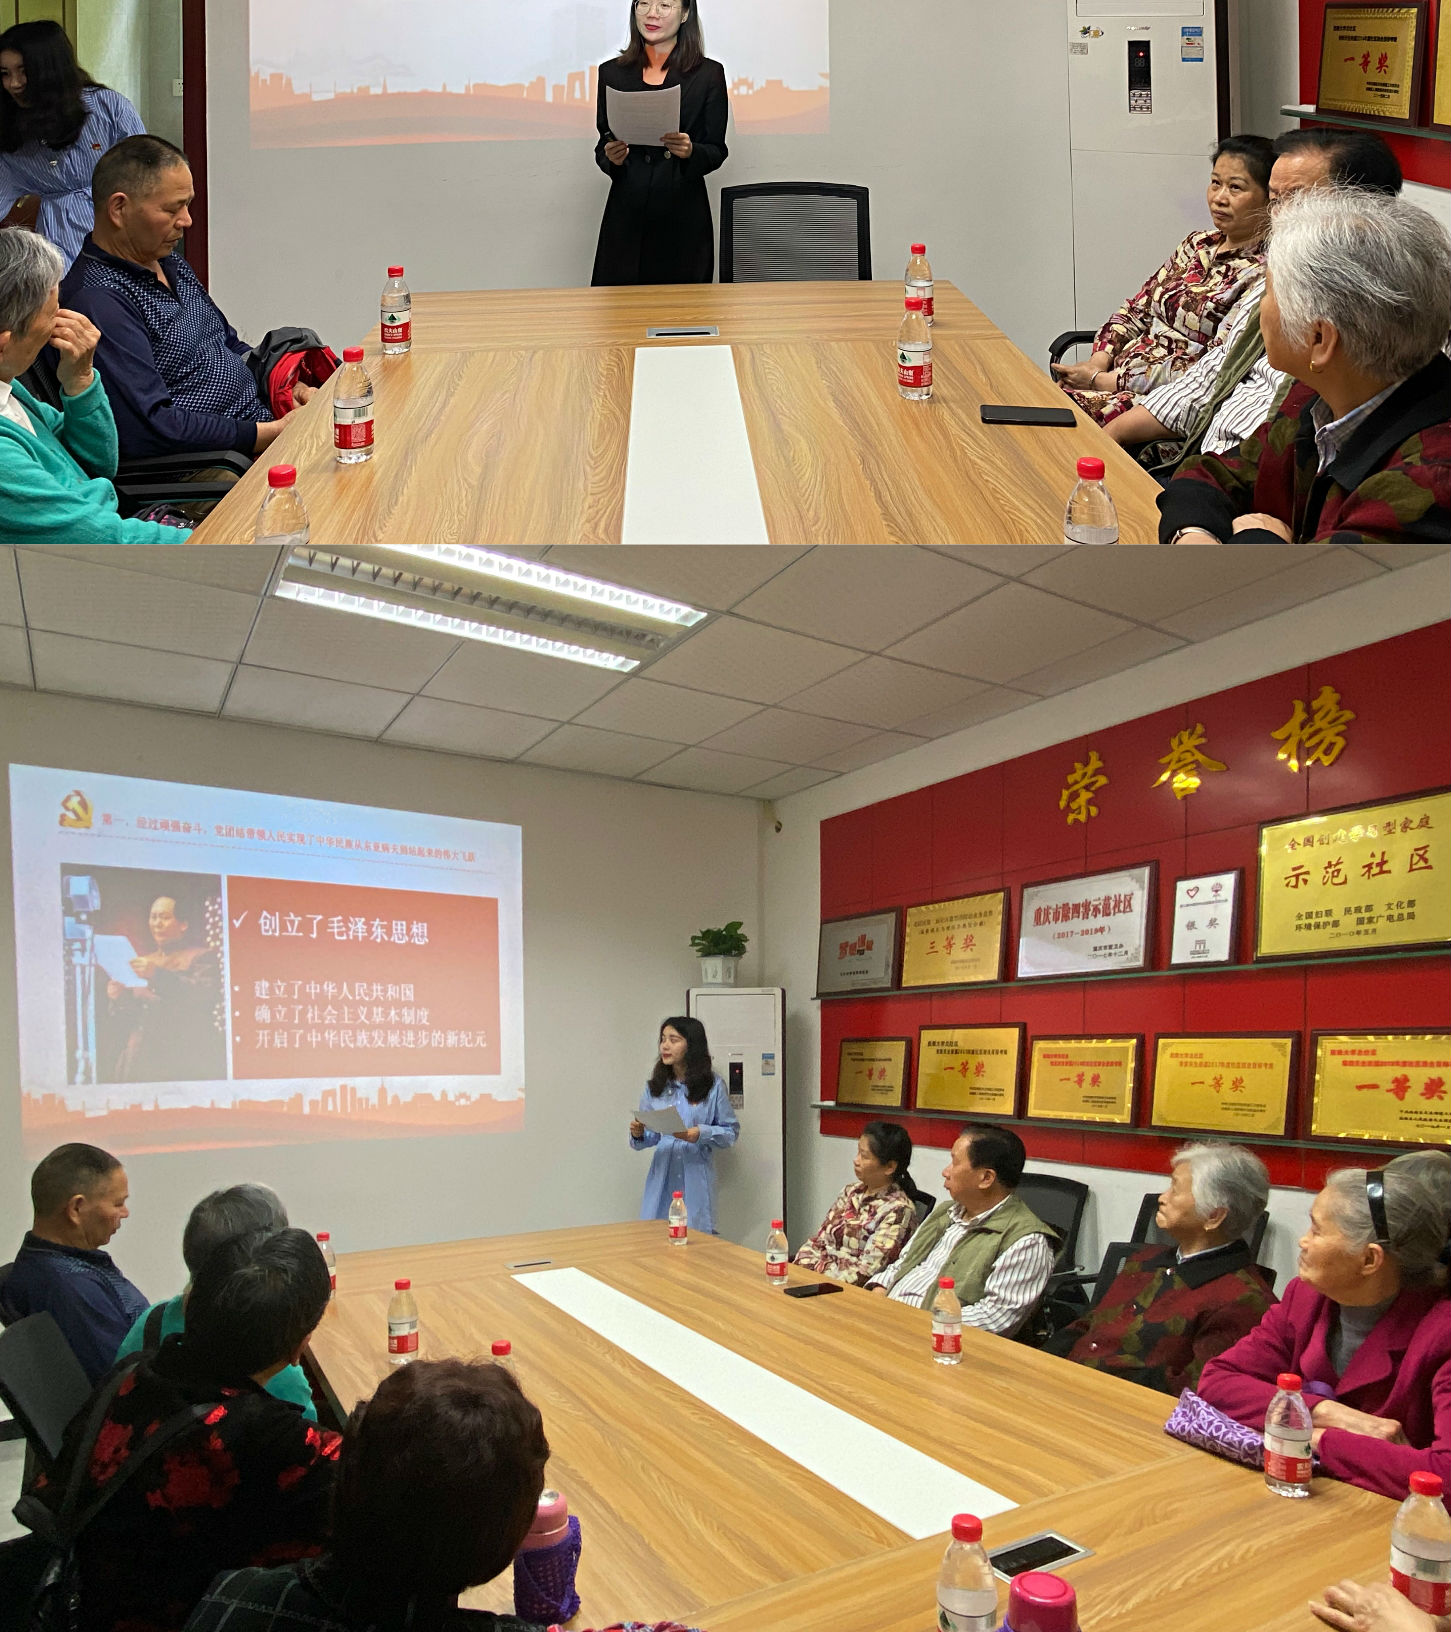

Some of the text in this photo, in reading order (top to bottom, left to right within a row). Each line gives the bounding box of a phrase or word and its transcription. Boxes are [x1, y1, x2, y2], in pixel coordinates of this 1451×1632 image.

[1344, 50, 1389, 75] 一等奖
[1058, 685, 1356, 826] 荣誉榜
[1284, 844, 1434, 889] 示范社区
[1033, 892, 1134, 928] 重庆市除四害示范社区
[258, 910, 430, 945] 创立了毛泽东思想
[925, 933, 977, 956] 三等奖
[254, 979, 415, 1001] 建立了中华人民共和国
[254, 1005, 430, 1025] 确立了社会主义基本制度
[255, 1029, 487, 1049] 开启了中华民族发展进步的新纪元
[943, 1060, 986, 1078] 一等奖
[1059, 1071, 1102, 1088] 一等奖
[1190, 1074, 1246, 1094] 一等奖
[1355, 1073, 1448, 1101] 一等奖
